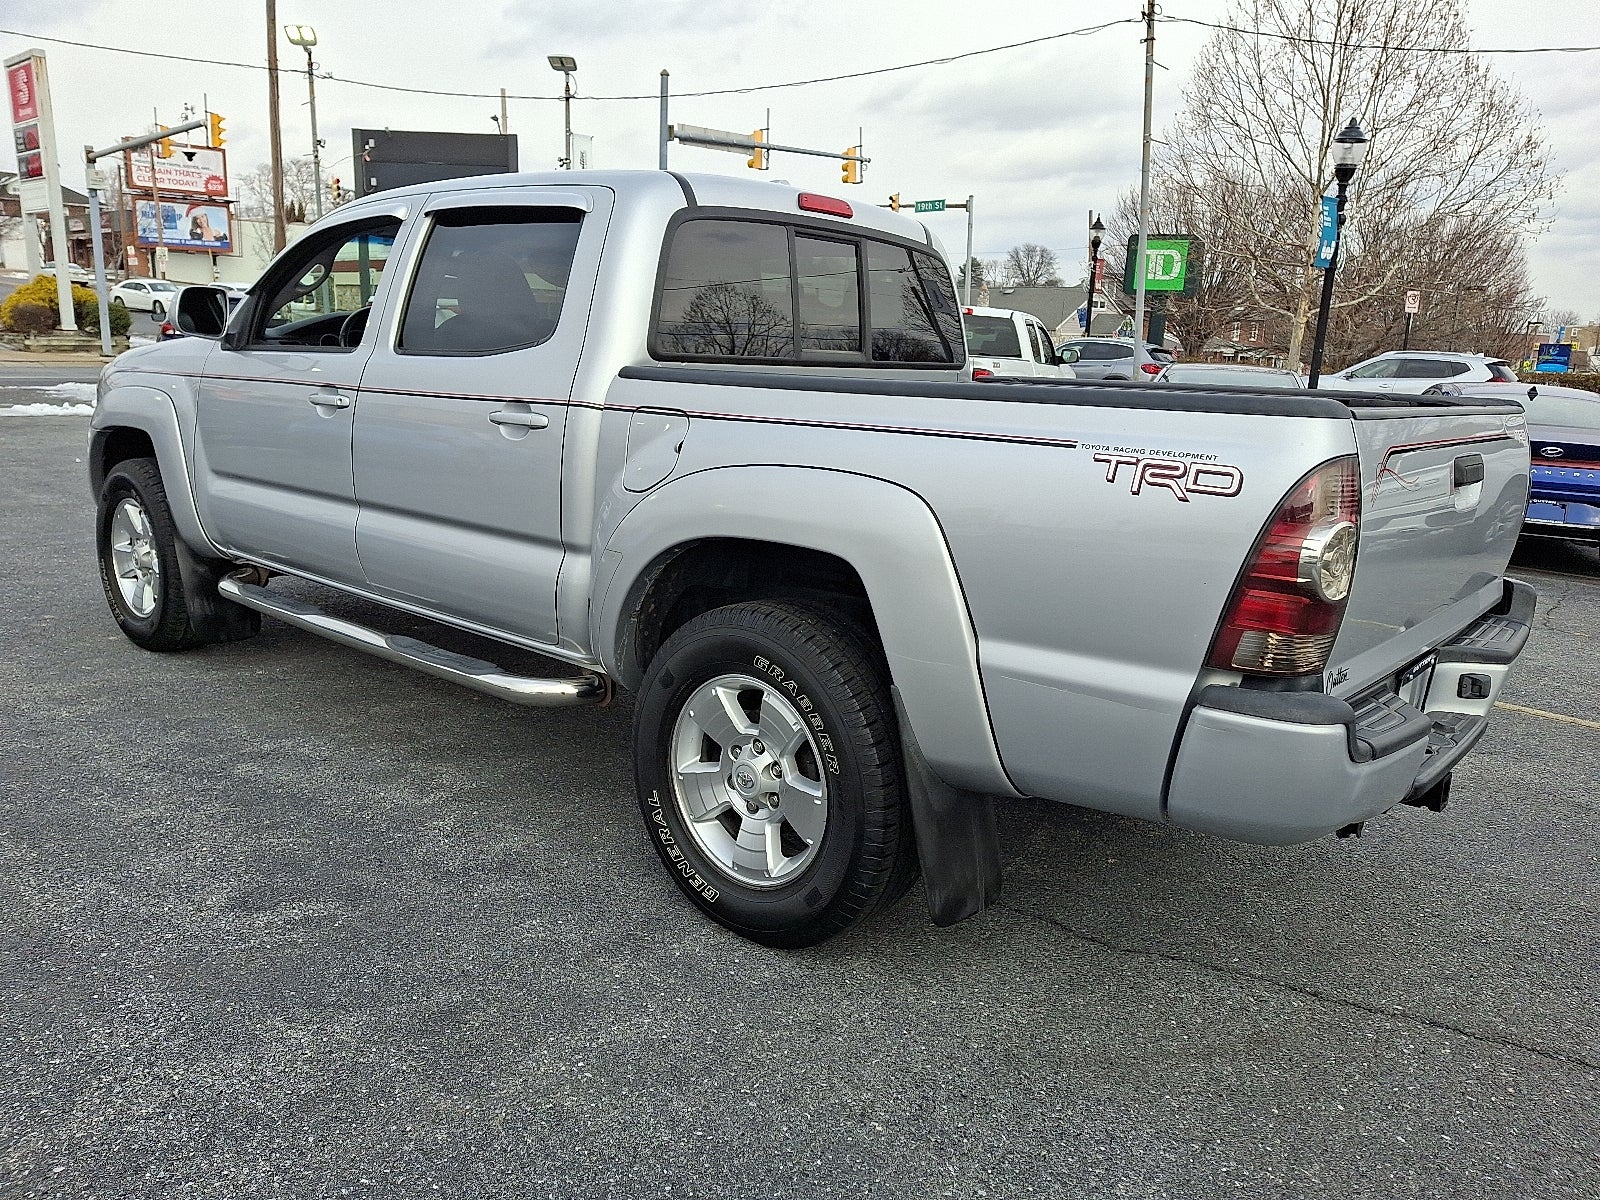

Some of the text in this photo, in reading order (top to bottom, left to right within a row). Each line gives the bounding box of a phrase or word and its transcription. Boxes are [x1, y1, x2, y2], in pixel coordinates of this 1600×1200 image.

[144, 166, 172, 176] DAIN
[167, 178, 199, 188] TODAY!
[917, 201, 943, 211] 19th St
[1145, 249, 1181, 281] TD
[1081, 443, 1219, 462] TOYOTA RACING DEVELOPMENT
[1093, 453, 1244, 503] TRD
[753, 655, 840, 775] GRABBER
[648, 790, 720, 903] GENERAL
